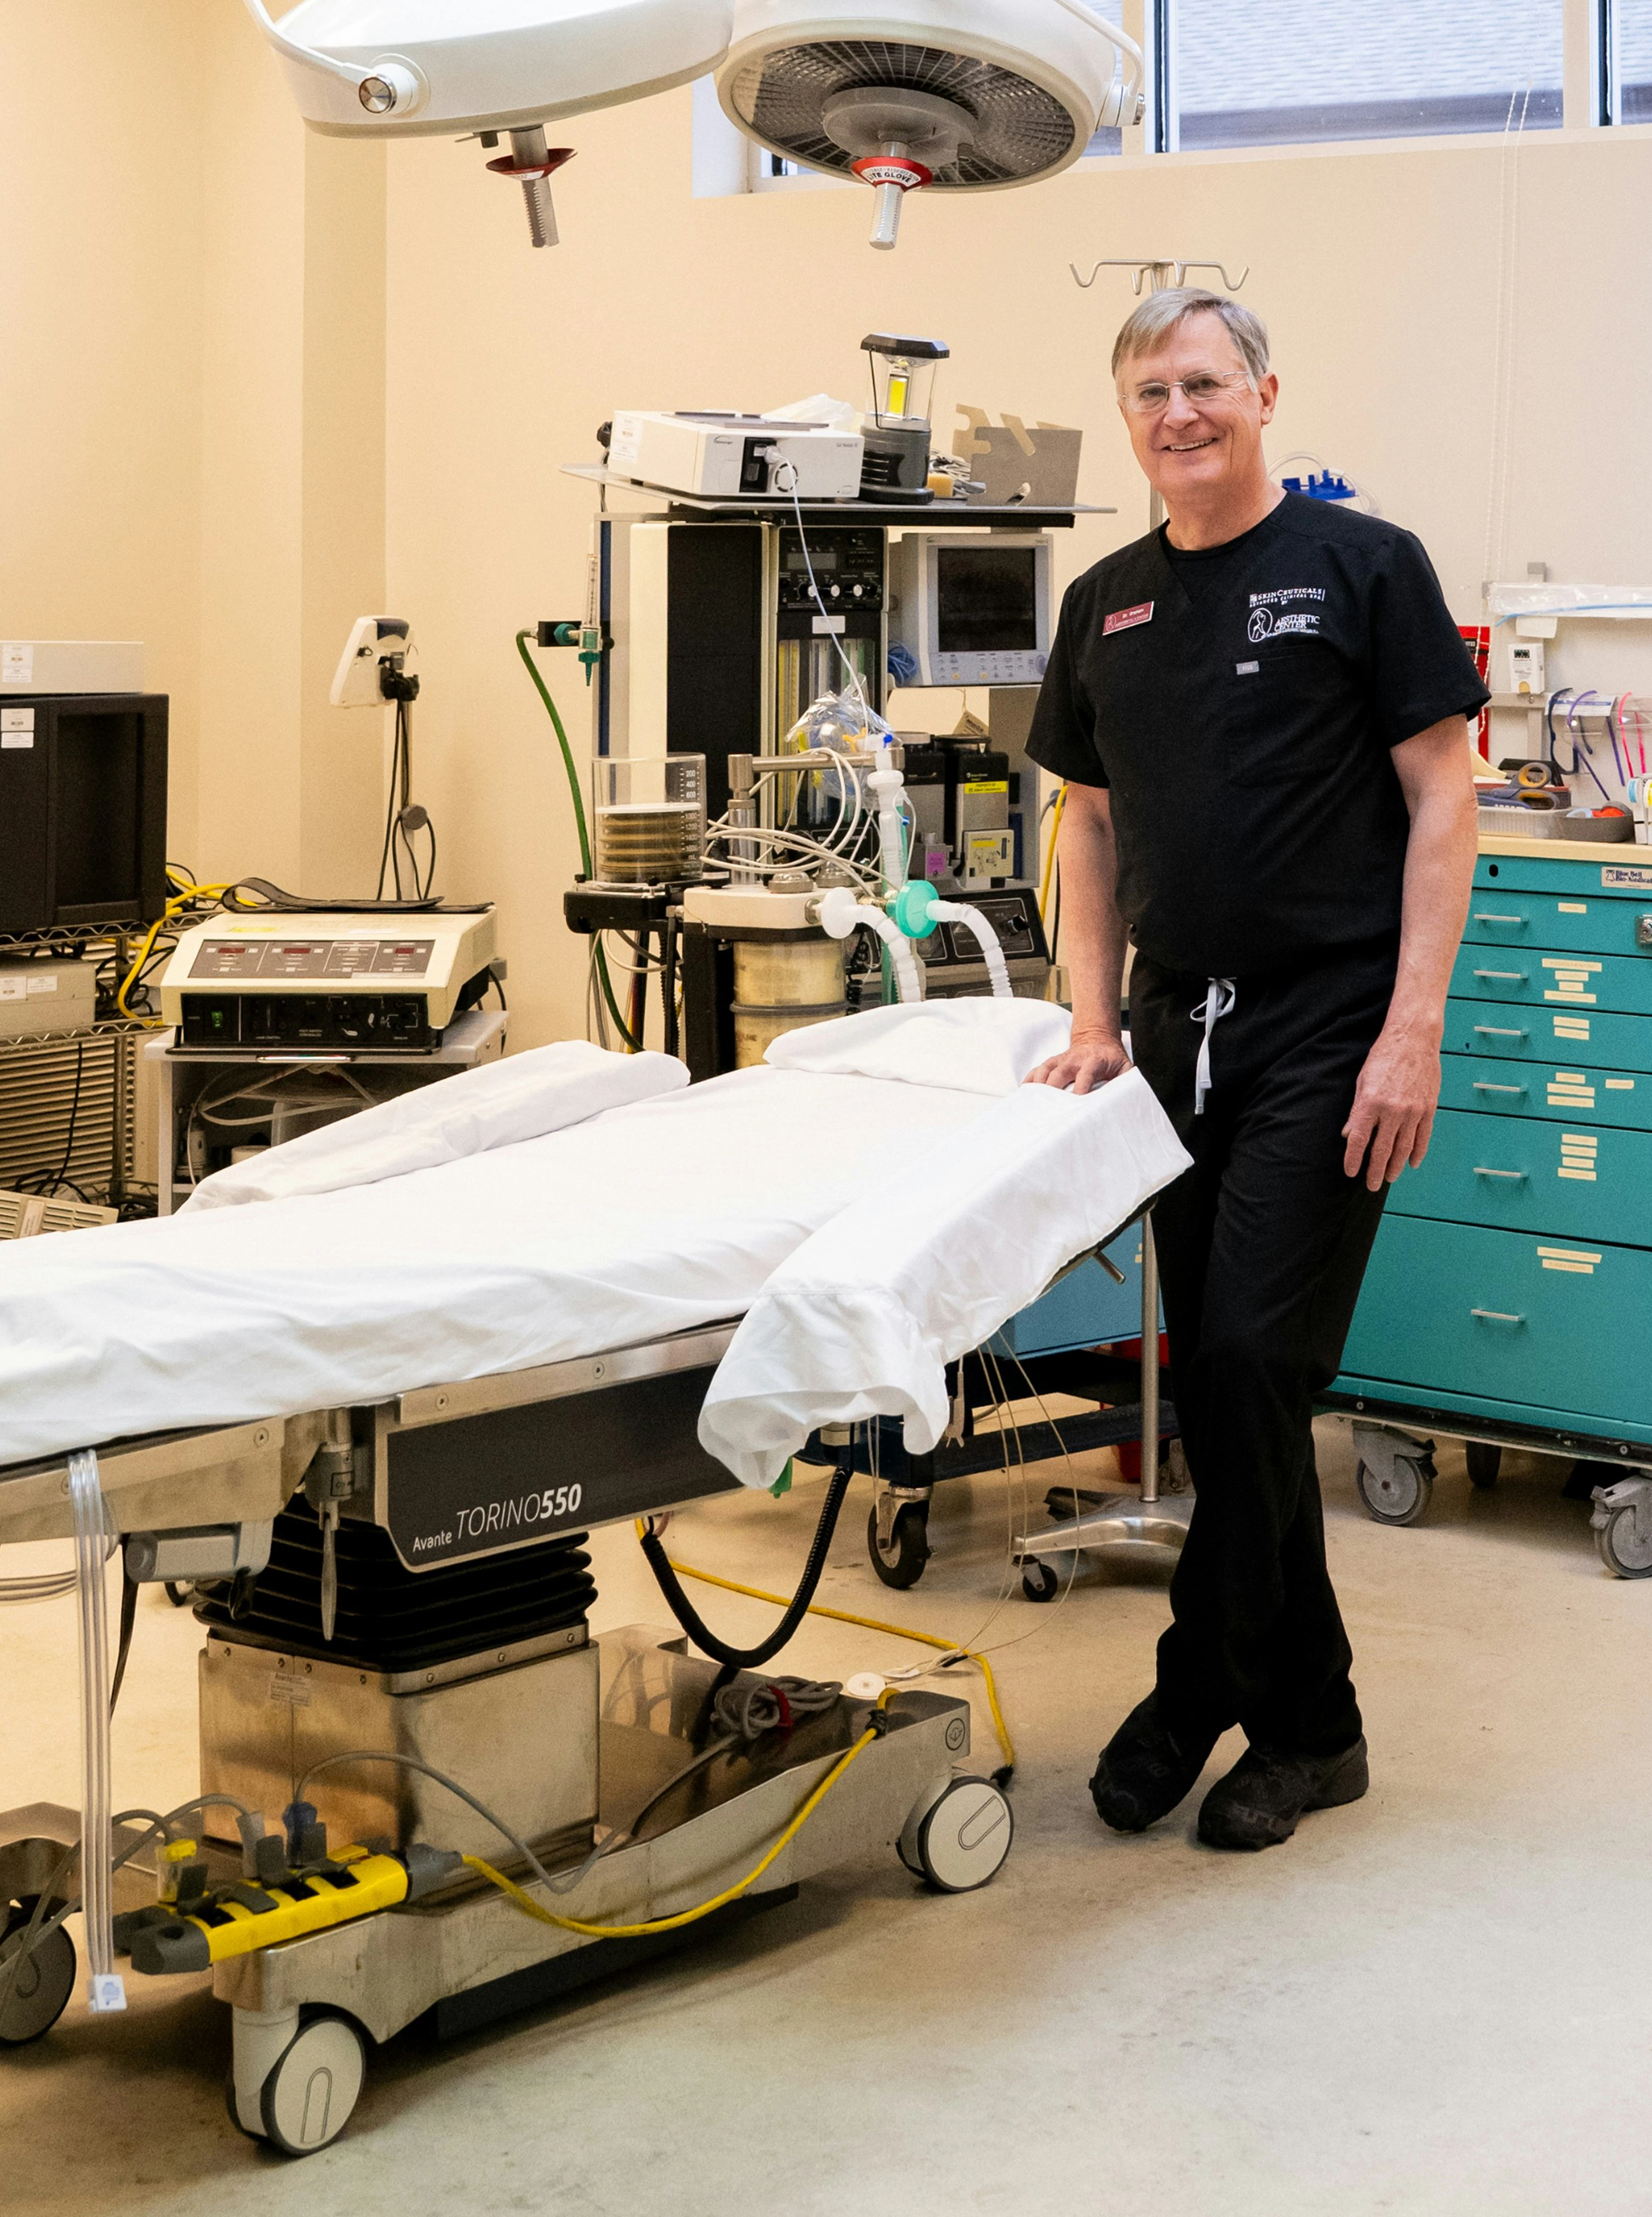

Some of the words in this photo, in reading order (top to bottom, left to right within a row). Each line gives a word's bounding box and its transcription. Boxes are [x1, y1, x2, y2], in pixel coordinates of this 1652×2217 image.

[884, 172, 911, 183] GLOVE
[1274, 621, 1307, 632] CENTER
[412, 1530, 452, 1552] Avante
[456, 1483, 582, 1540] TORINO550
